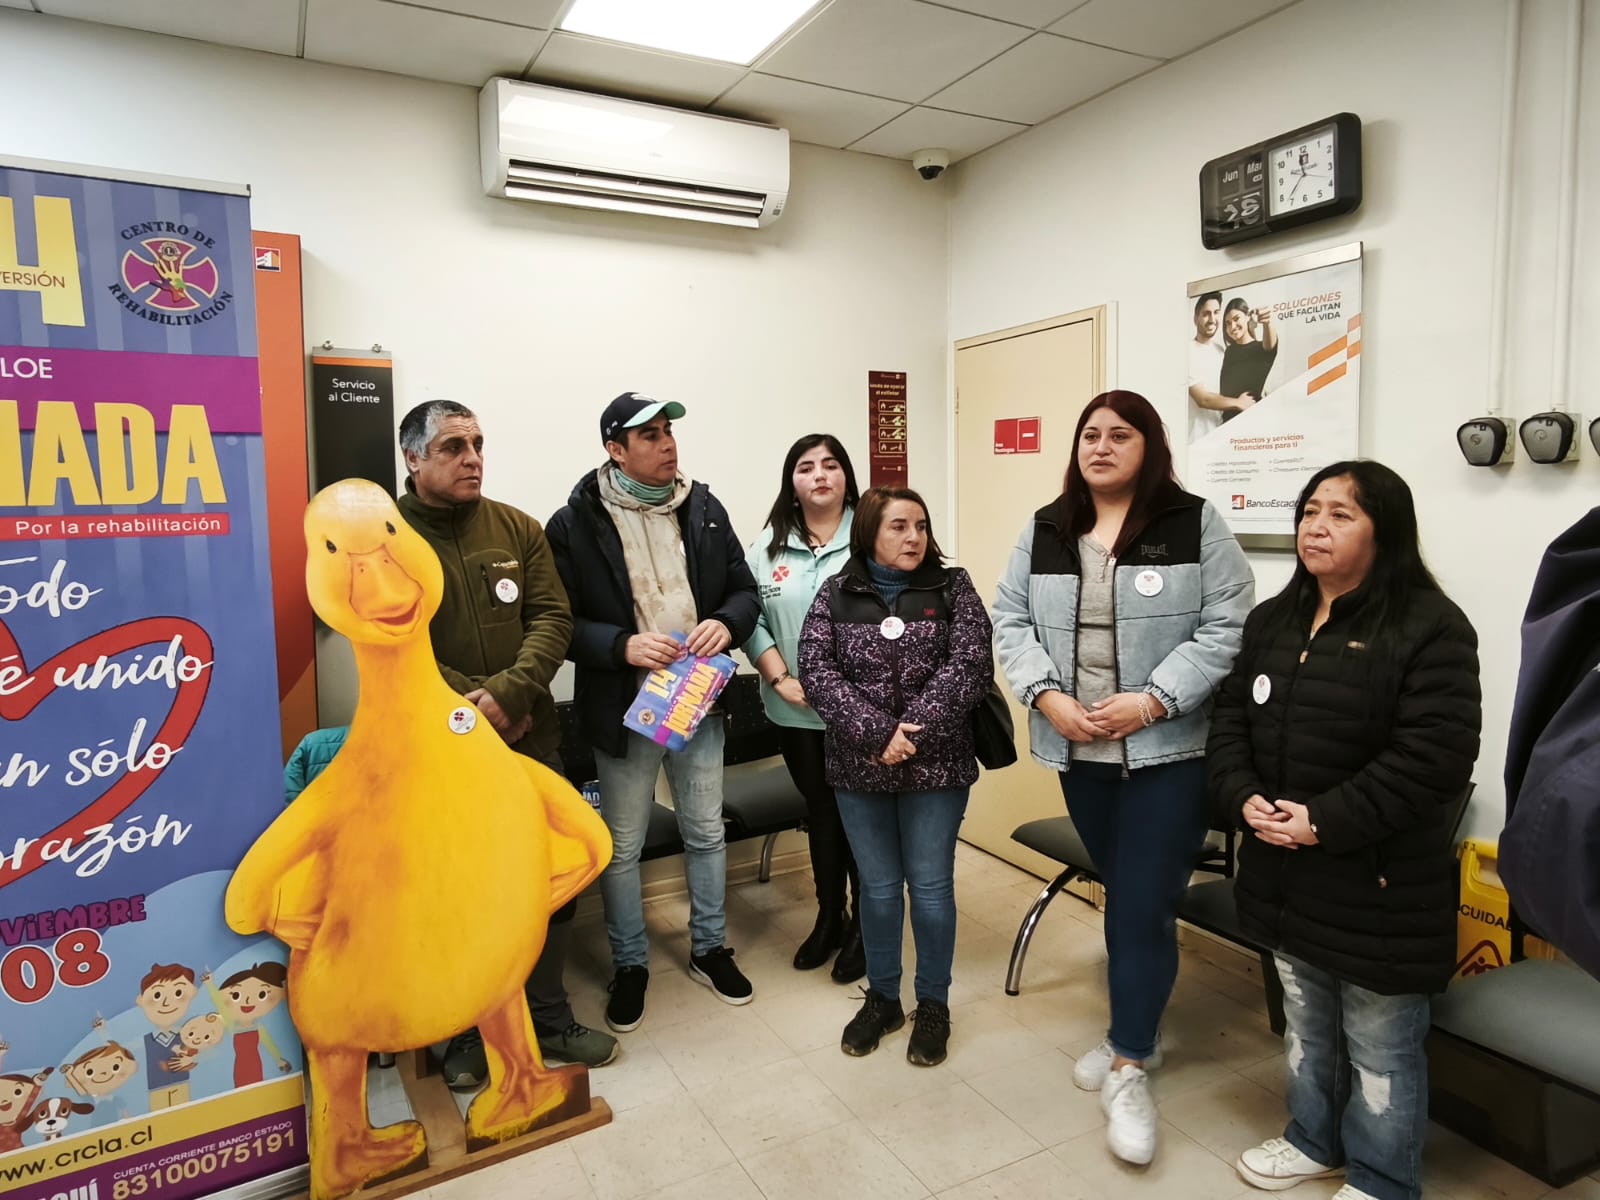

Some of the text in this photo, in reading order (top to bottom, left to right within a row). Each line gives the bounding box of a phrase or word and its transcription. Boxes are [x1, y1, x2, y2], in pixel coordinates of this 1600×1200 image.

[1222, 170, 1239, 183] Jun
[120, 221, 216, 249] CENTRO DE
[108, 283, 234, 326] REHABILITACIÓN
[1272, 290, 1342, 313] SOLUCIONES
[1277, 302, 1341, 321] QUE FACILITAN
[1305, 311, 1341, 324] LA VIDA
[328, 392, 380, 403] al Cliente
[331, 378, 376, 390] Servicio
[1230, 436, 1265, 445] Productos
[1272, 433, 1305, 442] servicios
[1246, 499, 1299, 509] BancoEstad
[15, 517, 221, 536] Por la rehabilitación
[0, 556, 104, 618] odo
[54, 634, 214, 691] unido
[0, 717, 183, 788] n sólo
[0, 814, 192, 878] razón
[0, 927, 111, 1005] 08
[0, 1125, 153, 1182] ww.crcla.cl
[112, 1128, 295, 1200] 83100075191
[113, 1120, 293, 1180] CUENTA CORRIENTE BANCO ESTADO
